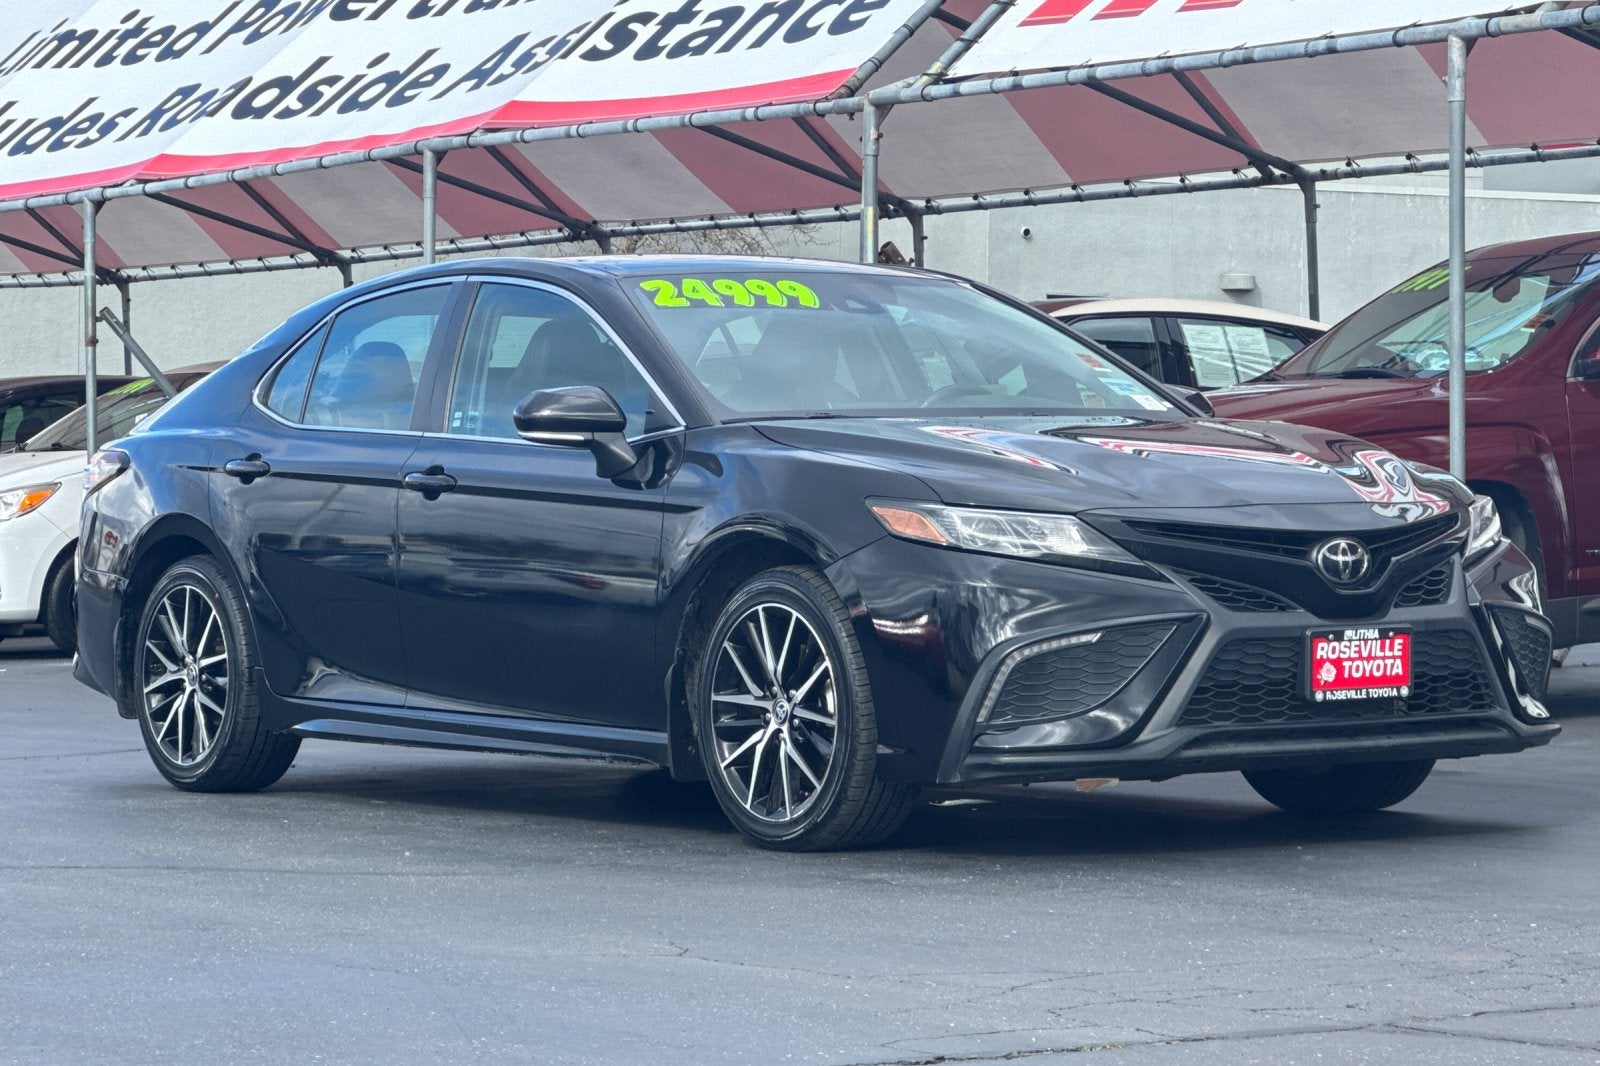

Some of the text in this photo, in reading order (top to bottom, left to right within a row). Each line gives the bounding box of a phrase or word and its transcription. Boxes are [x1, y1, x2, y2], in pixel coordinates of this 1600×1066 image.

[0, 0, 243, 76] Limited
[113, 47, 451, 143] Roadside
[428, 0, 891, 101] Assistance
[640, 278, 820, 308] 24999
[1352, 629, 1379, 640] LITHIA
[1316, 639, 1403, 660] ROSEVILLE
[1342, 659, 1403, 678] TOYOTA
[1326, 687, 1398, 700] ROSEVILLE TOYOTA
